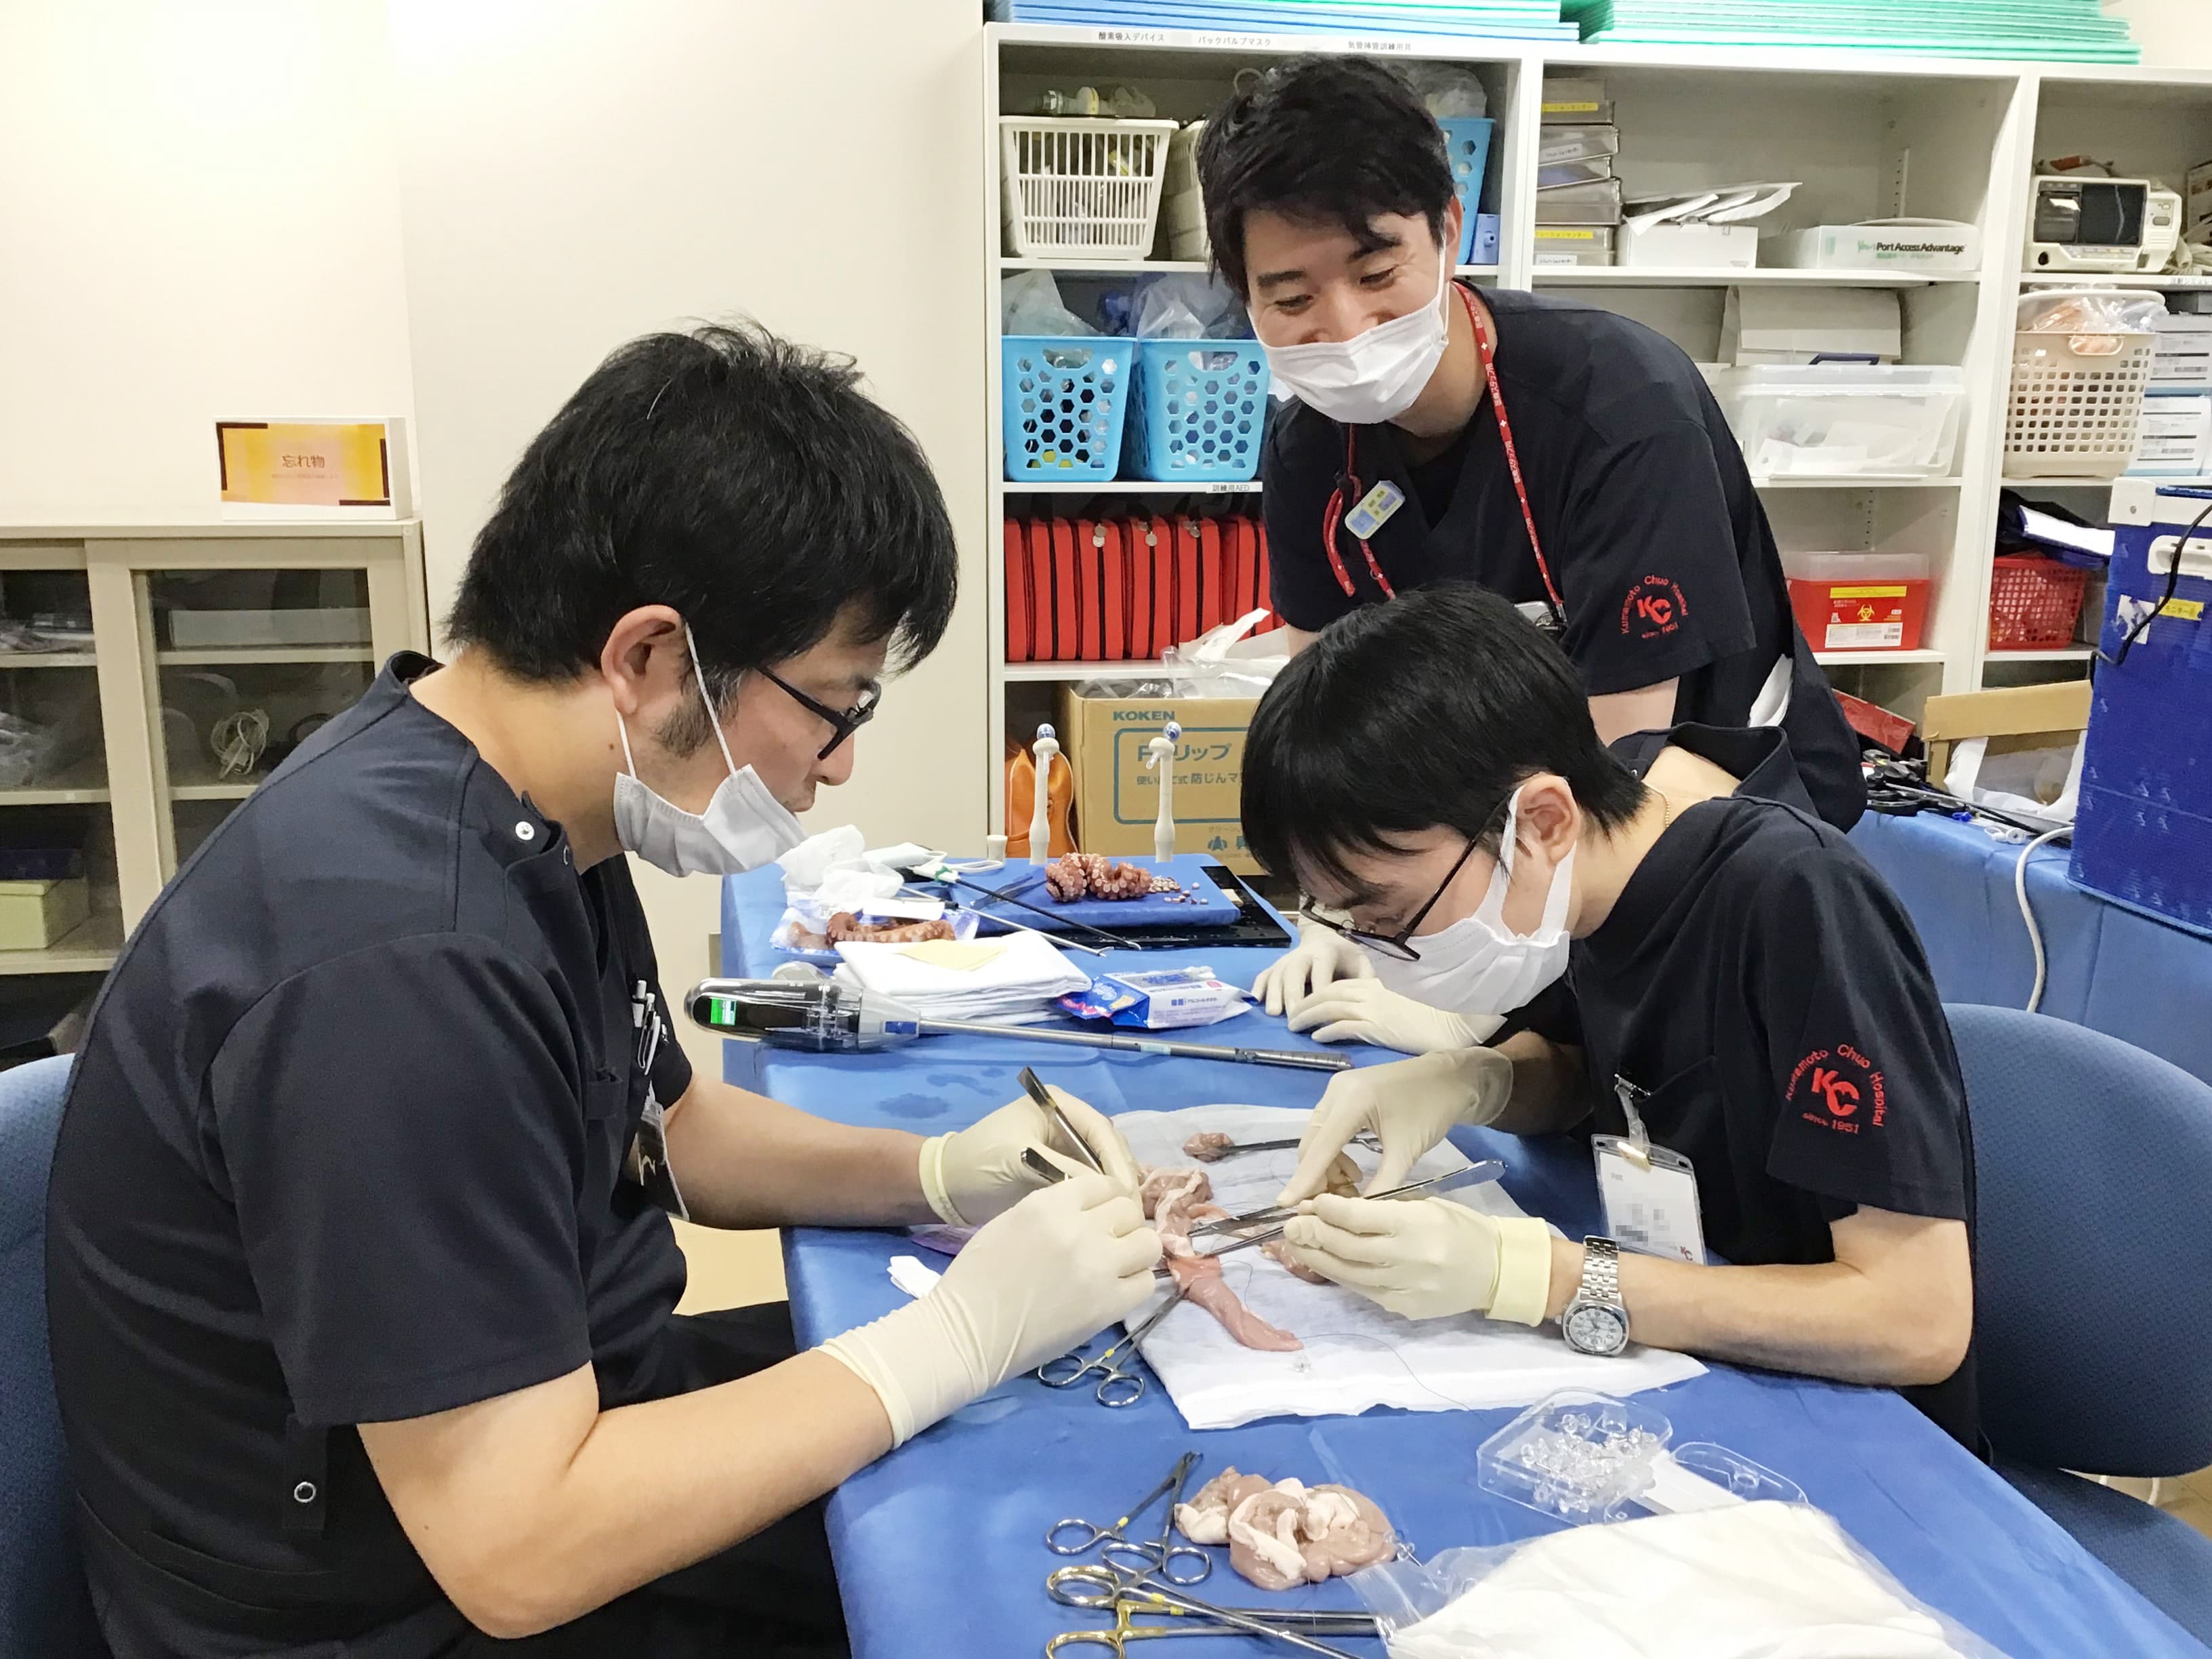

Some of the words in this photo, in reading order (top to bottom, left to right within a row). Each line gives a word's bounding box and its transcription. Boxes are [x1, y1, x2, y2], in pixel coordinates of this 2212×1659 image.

[1099, 32, 1165, 42] 酸素吸入デバイス
[1877, 242, 1893, 251] Port
[1895, 242, 1921, 252] Access
[1921, 243, 1965, 255] Advantage
[282, 455, 325, 468] 忘れ物
[1643, 575, 1670, 586] Chuo
[1637, 595, 1672, 624] KC
[1113, 711, 1175, 721] KOKEN
[1191, 773, 1243, 785] 防じんマ
[1784, 1050, 1829, 1101] Kumamoto
[1837, 1044, 1870, 1069] Chuo
[1870, 1071, 1887, 1127] Hospital
[1811, 1067, 1860, 1117] KC
[1832, 1120, 1860, 1134] 1951
